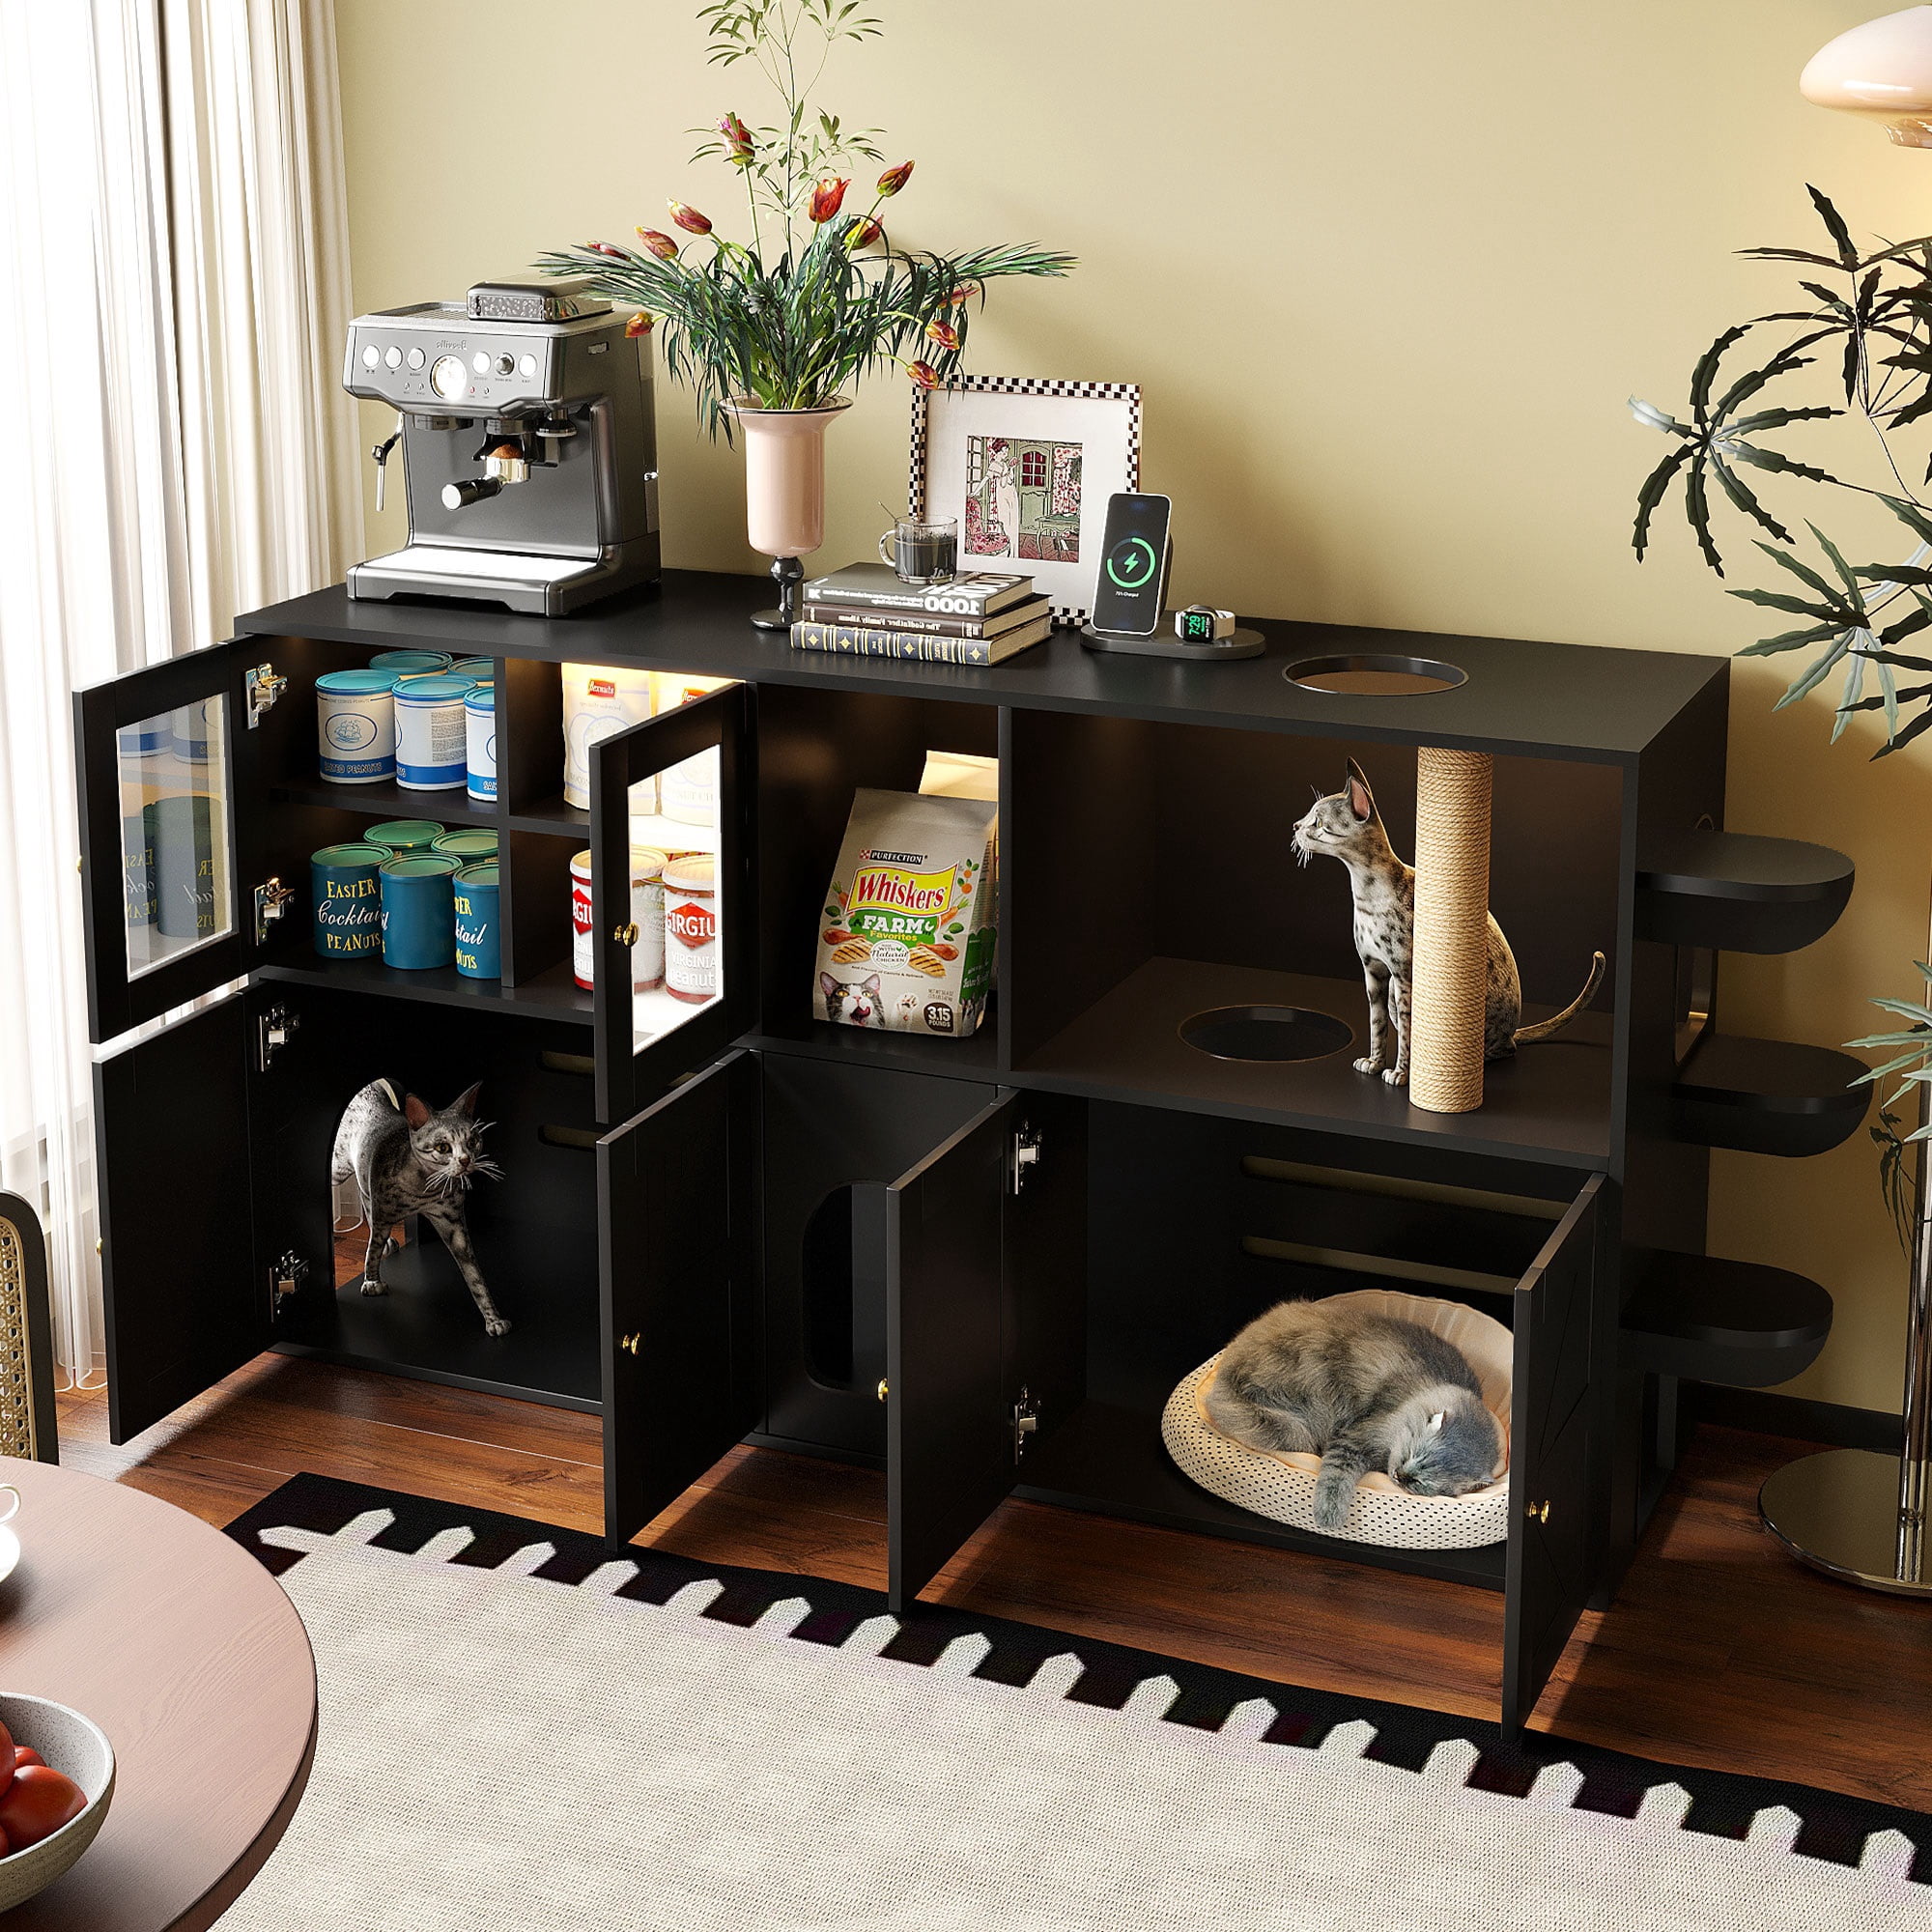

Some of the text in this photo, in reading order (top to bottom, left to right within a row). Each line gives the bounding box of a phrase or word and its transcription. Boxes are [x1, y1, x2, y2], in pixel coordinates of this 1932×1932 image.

[347, 762, 383, 773] PEANUTS
[871, 852, 922, 863] PURFECTION
[327, 879, 376, 899] EASTER
[857, 873, 945, 909] Whiskers
[317, 900, 382, 926] Cocktai
[455, 918, 487, 945] ktail
[862, 915, 925, 934] FARM
[327, 933, 381, 952] PEANUTS
[870, 930, 917, 941] Favorites
[455, 948, 478, 969] NUTS
[927, 1006, 951, 1022] 3.15
